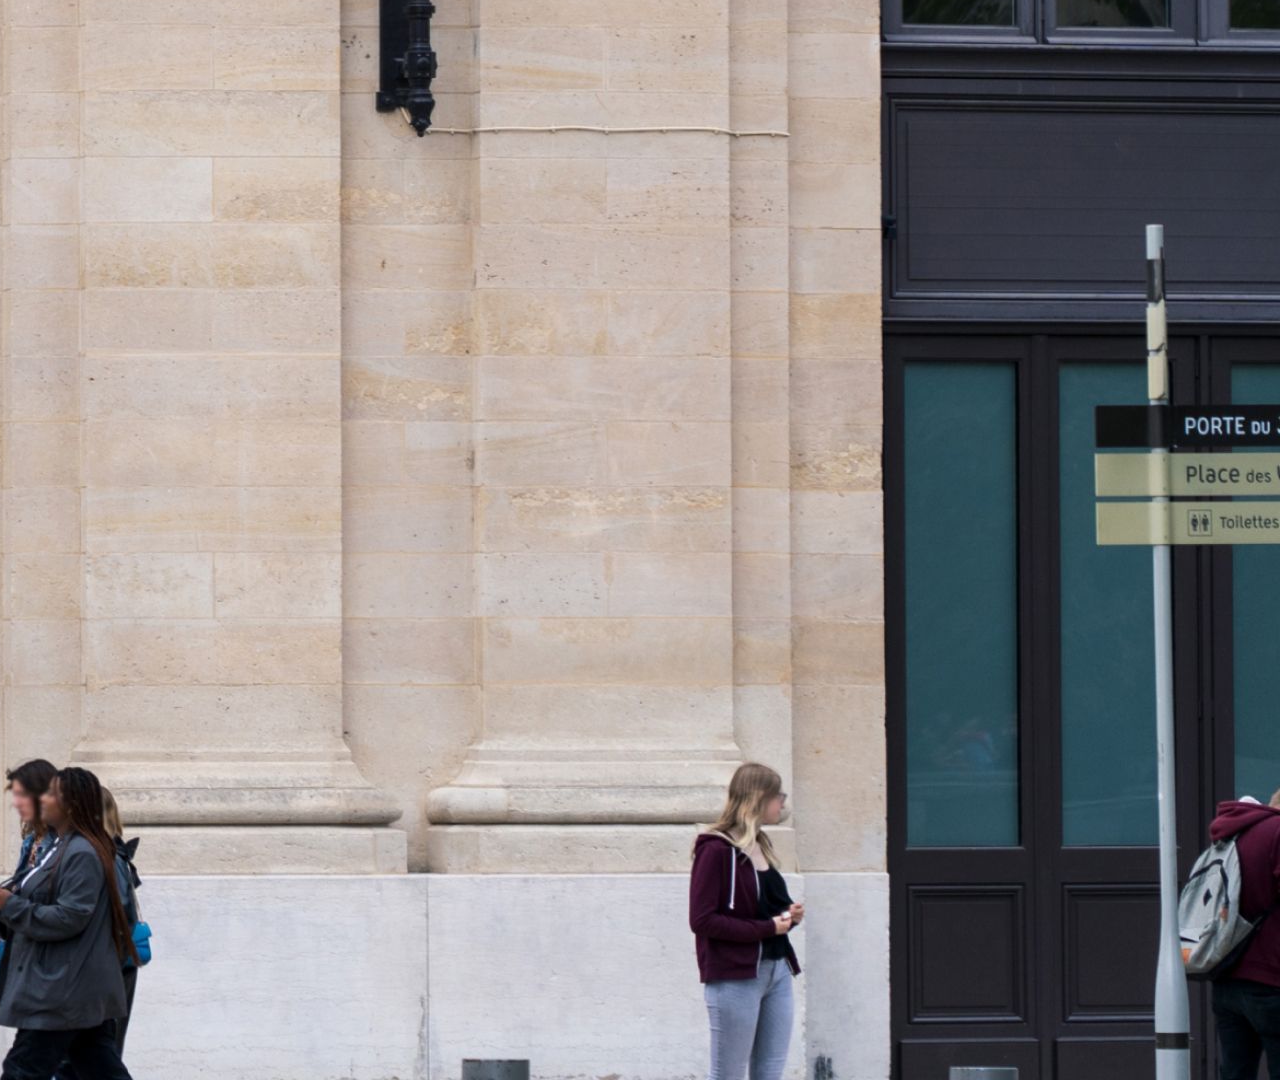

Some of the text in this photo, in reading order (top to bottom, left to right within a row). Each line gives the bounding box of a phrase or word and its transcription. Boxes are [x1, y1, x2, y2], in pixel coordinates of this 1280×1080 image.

[1185, 416, 1246, 435] PORTE
[1251, 420, 1271, 435] DU
[1186, 464, 1240, 484] Place
[1246, 469, 1272, 484] des
[1219, 515, 1280, 530] Toilettes
